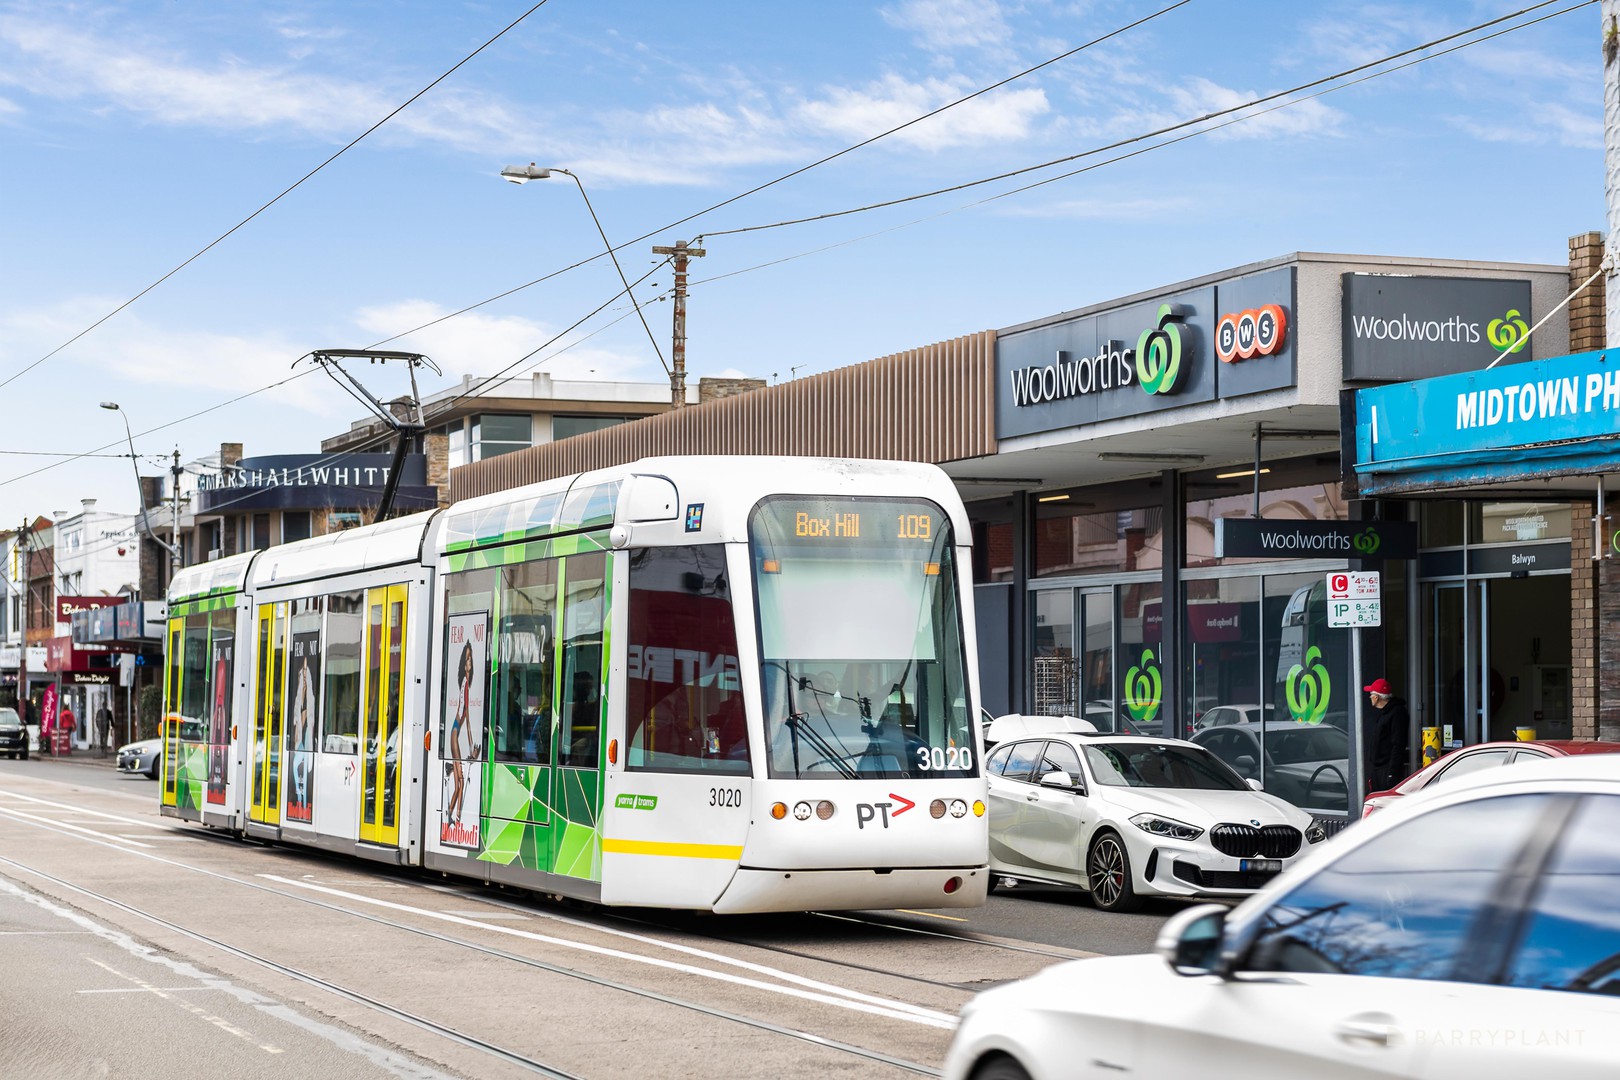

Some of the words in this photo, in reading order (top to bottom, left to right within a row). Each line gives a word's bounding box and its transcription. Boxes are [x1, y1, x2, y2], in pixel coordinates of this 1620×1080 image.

[1223, 320, 1270, 347] BWS
[1353, 313, 1481, 344] Woolworths
[1010, 339, 1132, 407] Woolworths
[1456, 376, 1580, 430] MIDTOWN
[206, 467, 308, 491] MARSHALL
[796, 512, 830, 538] Box
[835, 513, 860, 538] Hill
[897, 513, 932, 538] 109
[1260, 530, 1351, 551] Woolworths
[1511, 553, 1536, 566] Balwyn
[1335, 576, 1345, 591] C
[1334, 604, 1350, 617] 1P
[451, 625, 464, 644] FEAR
[473, 623, 485, 642] NOT
[294, 641, 304, 657] FEAR
[309, 640, 317, 656] NOT
[916, 746, 973, 771] 3020
[709, 787, 743, 809] 3020
[856, 802, 893, 830] PT
